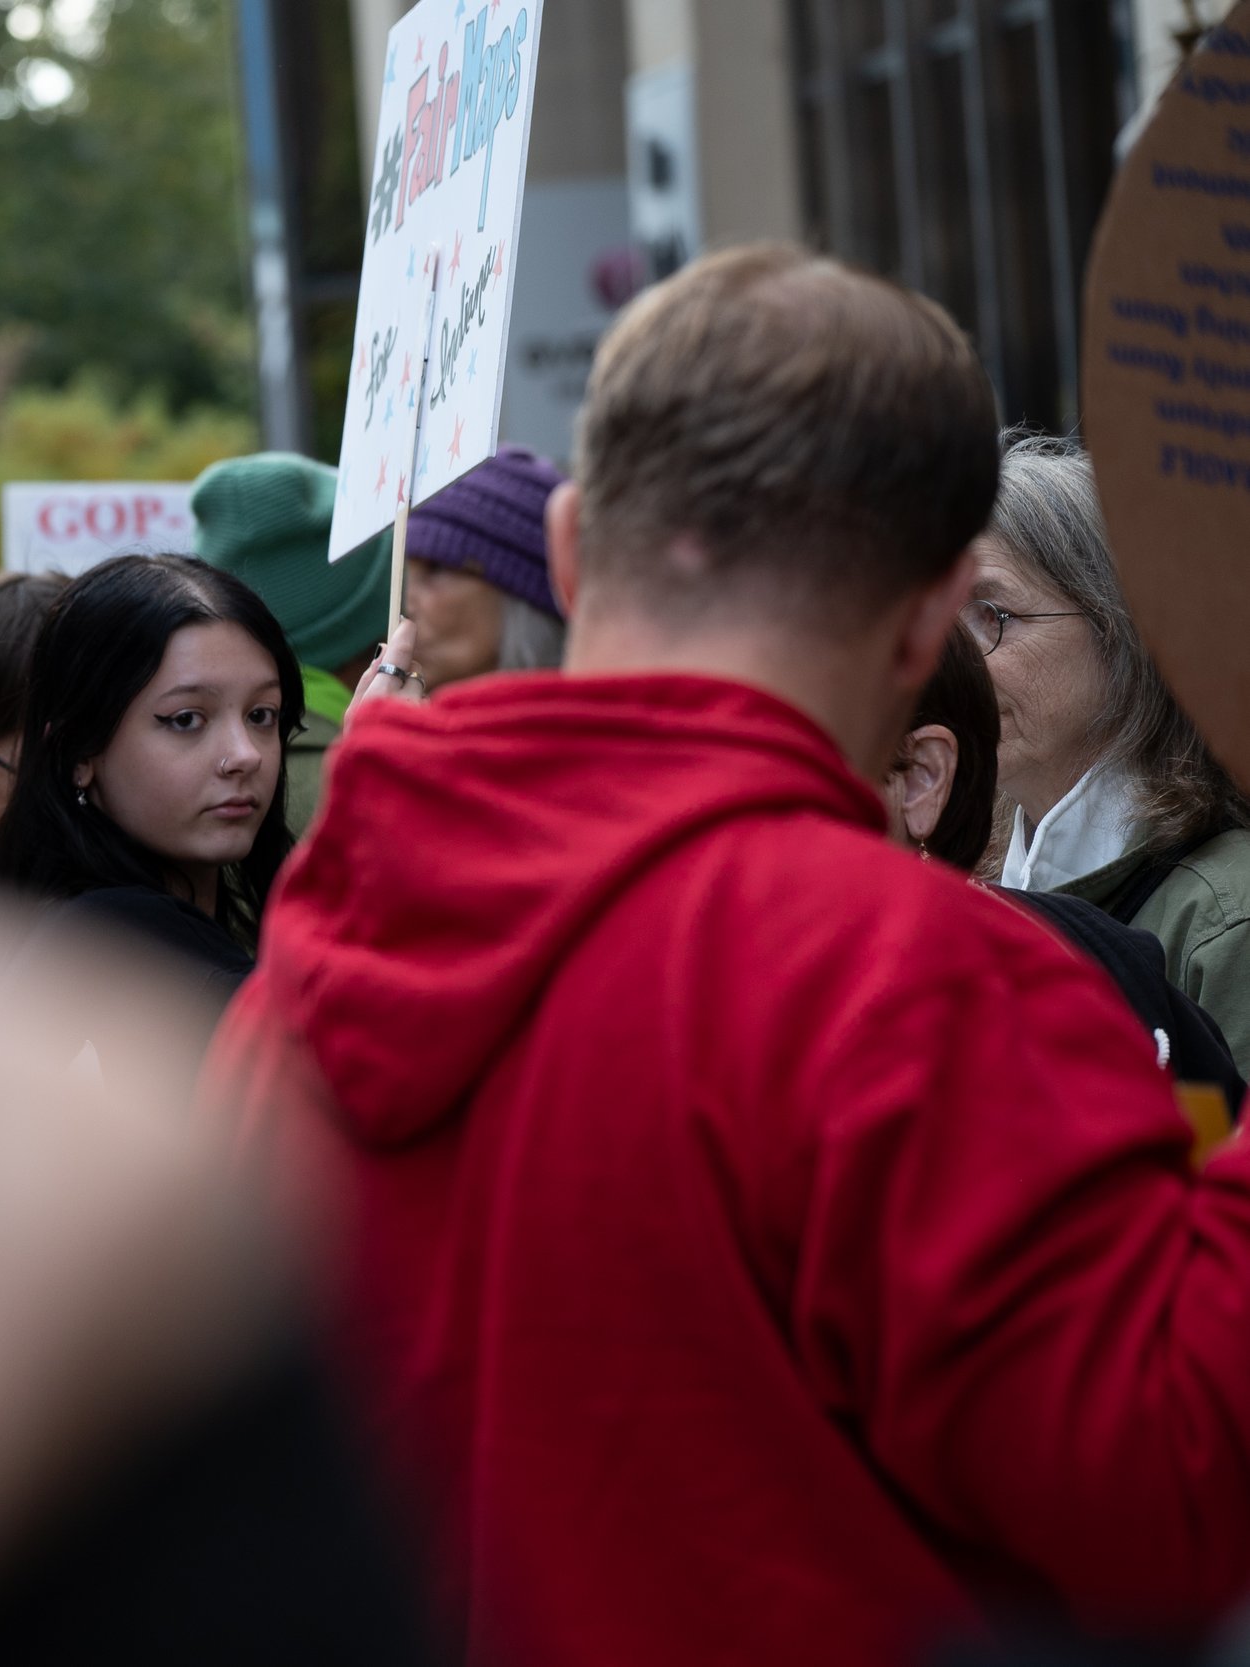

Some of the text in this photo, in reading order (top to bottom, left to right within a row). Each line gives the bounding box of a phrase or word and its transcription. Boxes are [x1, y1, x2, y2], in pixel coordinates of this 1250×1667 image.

[371, 4, 528, 247] #FairMaps
[364, 245, 497, 432] for Indiana
